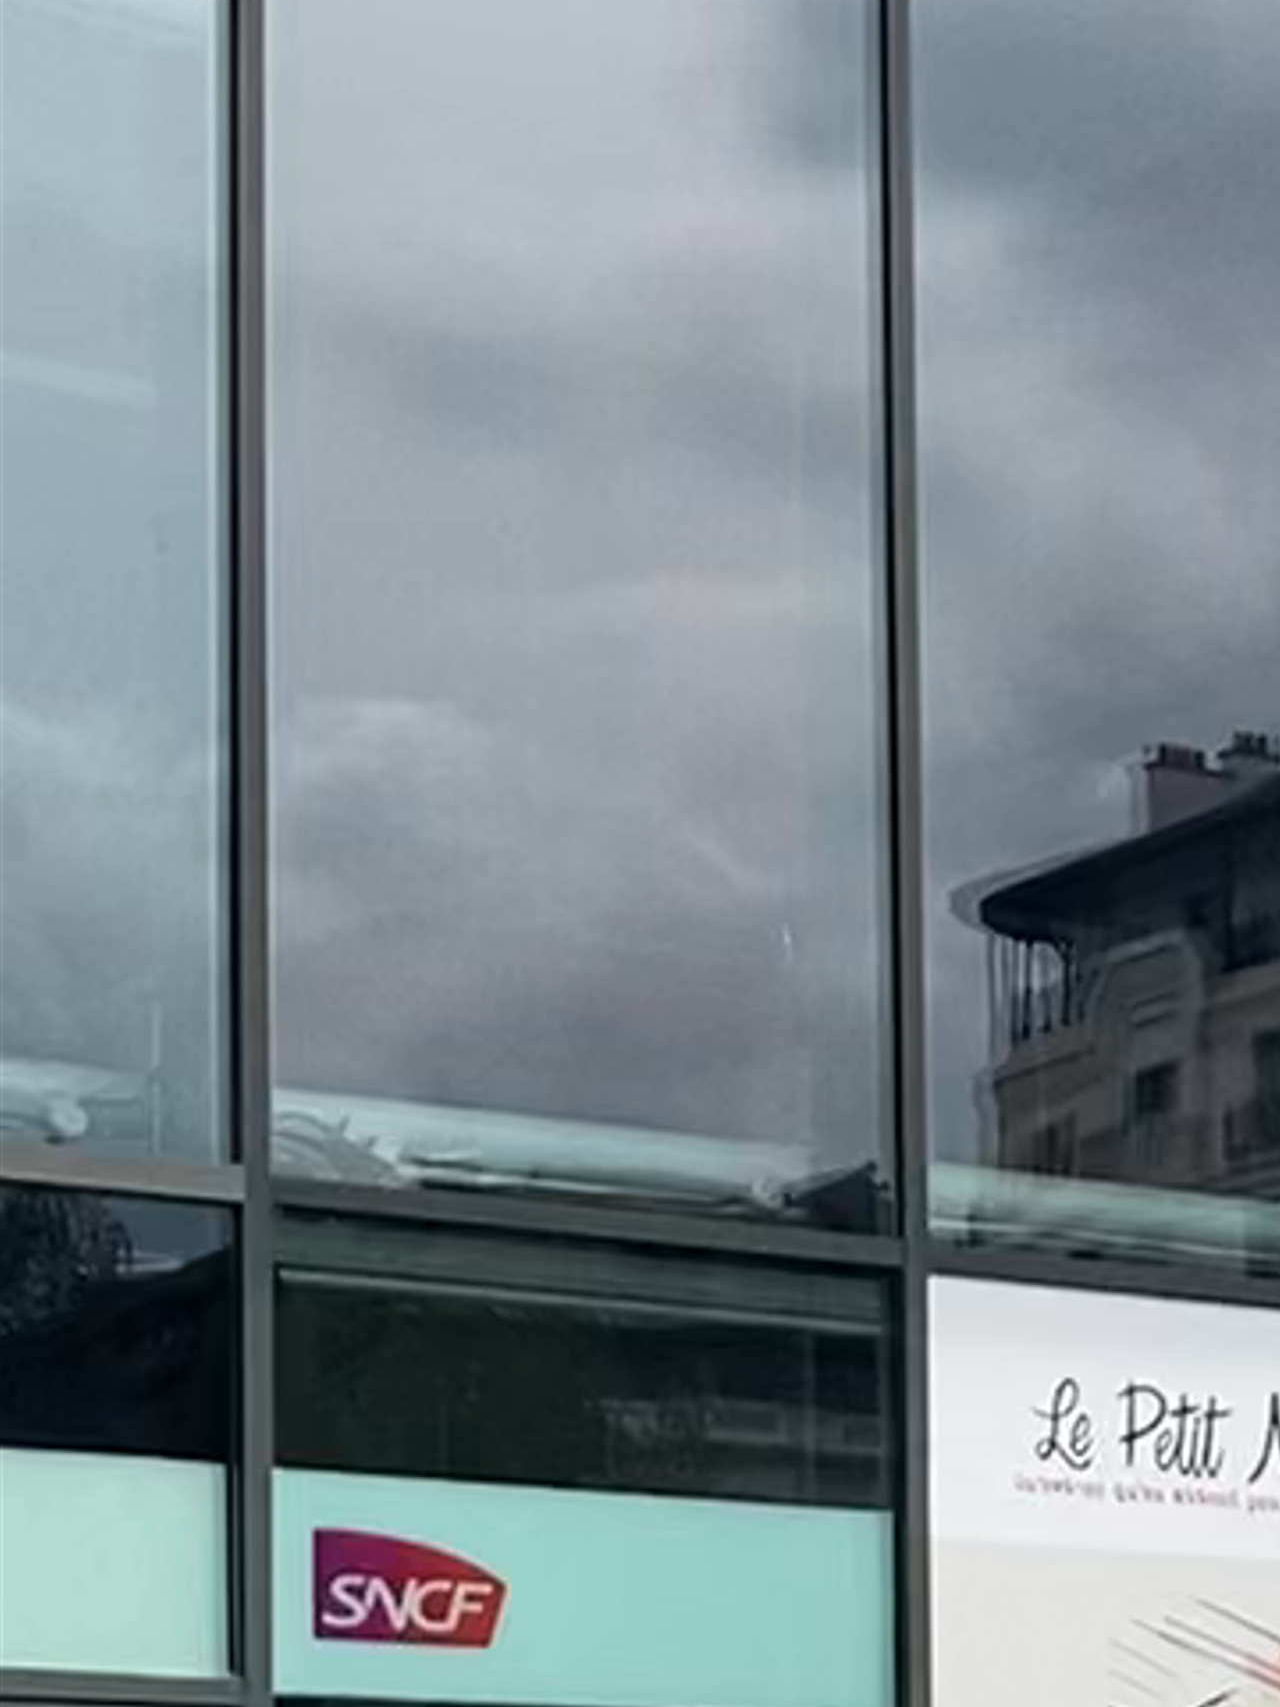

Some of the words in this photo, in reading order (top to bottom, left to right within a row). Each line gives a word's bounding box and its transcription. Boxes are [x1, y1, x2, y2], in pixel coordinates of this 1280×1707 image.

[1029, 1376, 1094, 1471] Le
[1117, 1379, 1232, 1478] Petit
[322, 1573, 495, 1632] SNCF
